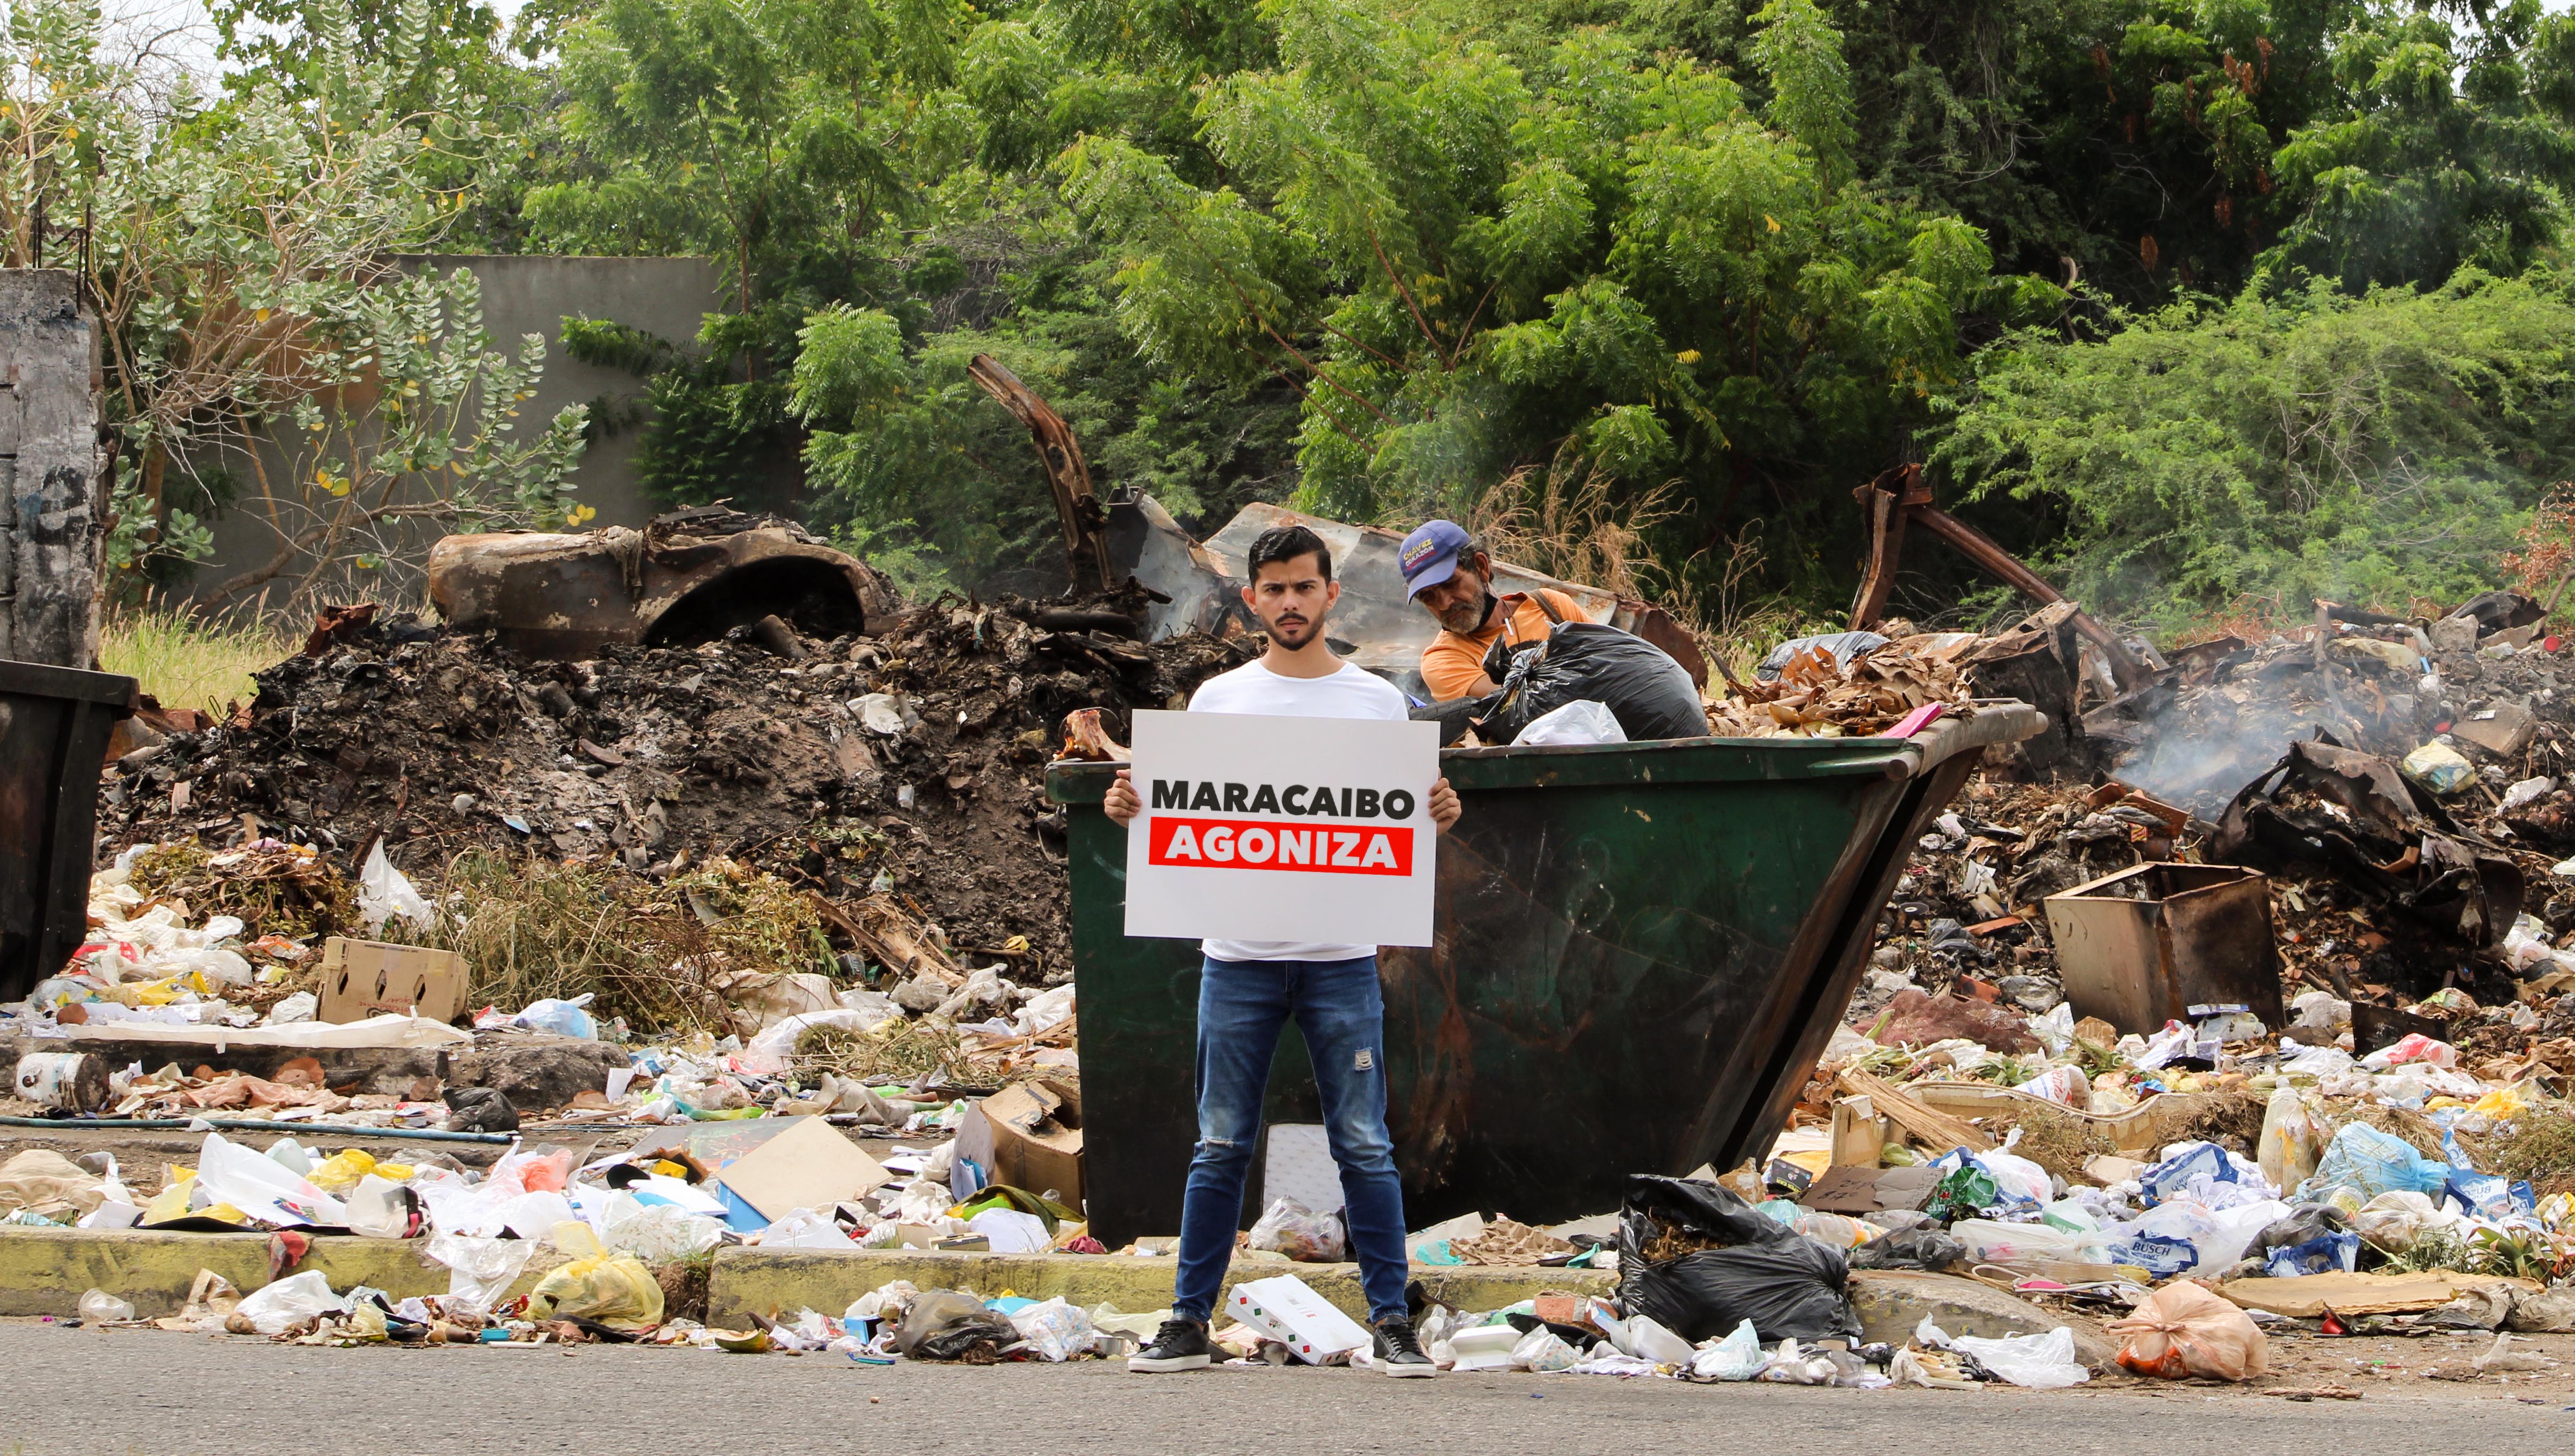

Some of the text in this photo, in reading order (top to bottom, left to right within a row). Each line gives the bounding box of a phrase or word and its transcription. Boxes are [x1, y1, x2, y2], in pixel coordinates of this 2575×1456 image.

[1152, 779, 1415, 820] MARACAIBO
[1164, 825, 1398, 869] AGONIZA
[2132, 1241, 2171, 1255] BUSCH
